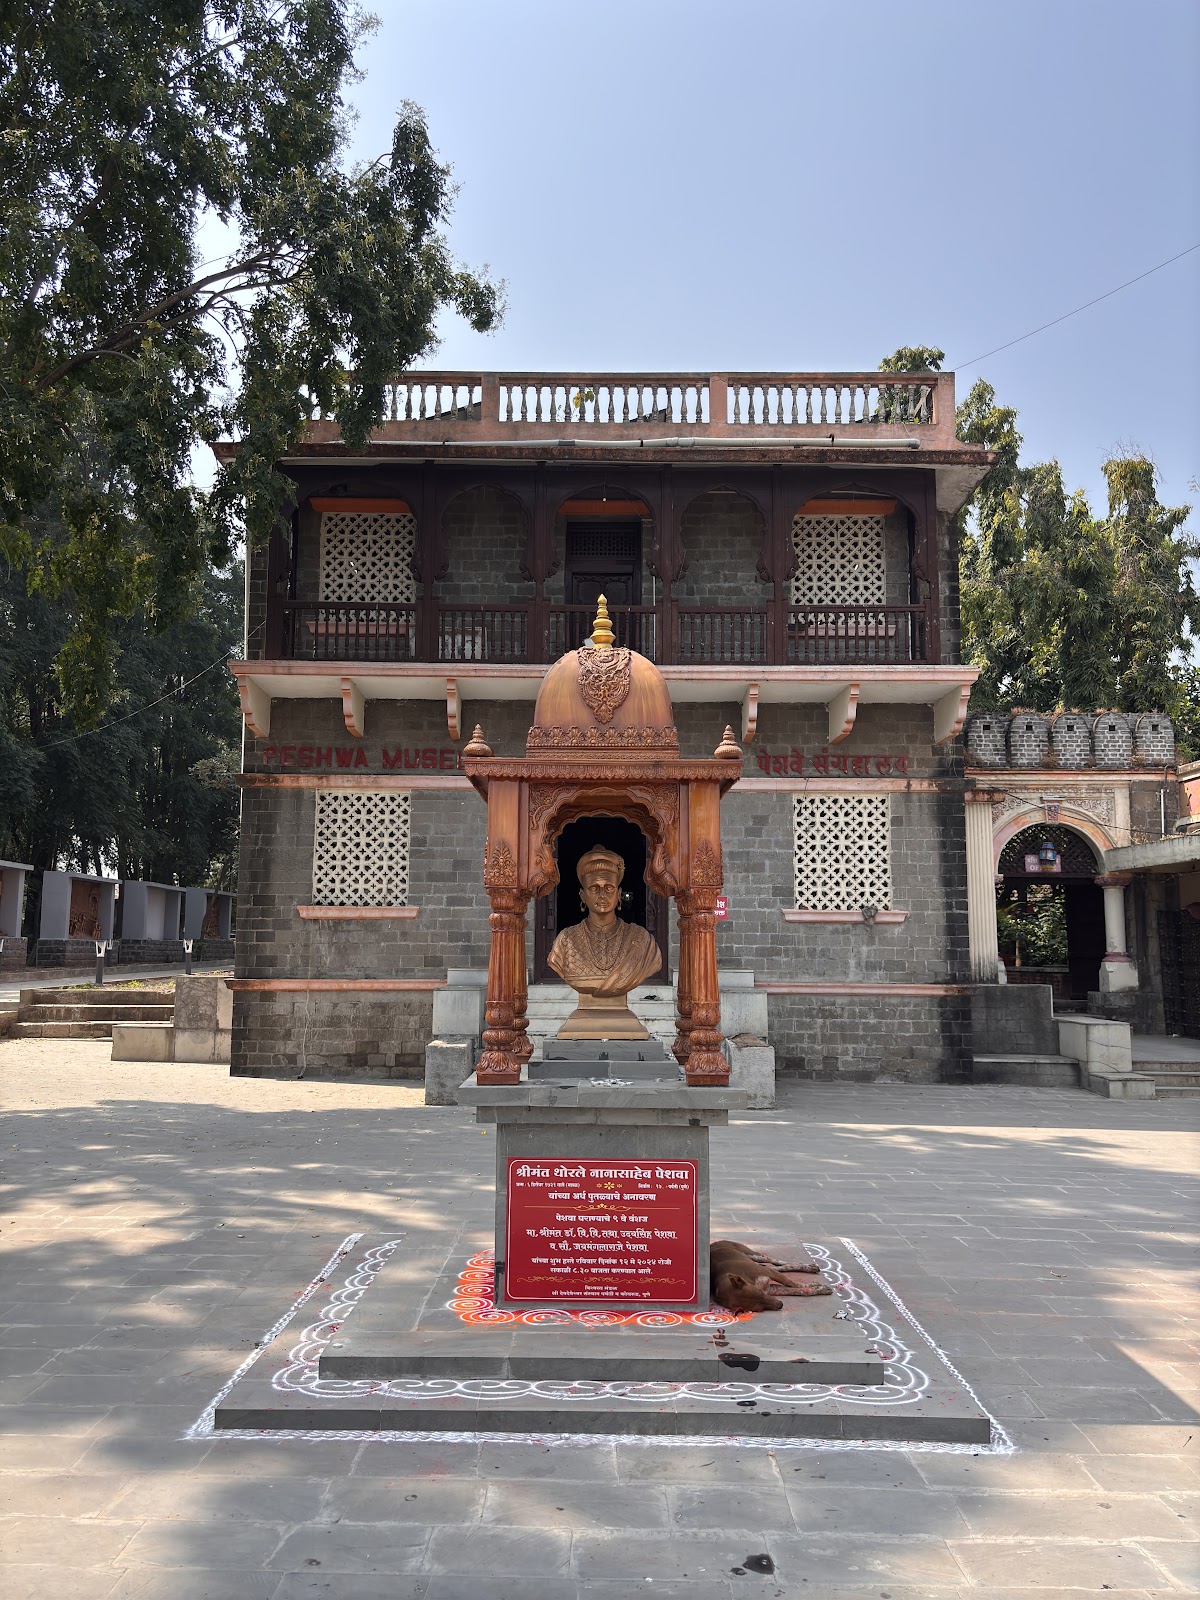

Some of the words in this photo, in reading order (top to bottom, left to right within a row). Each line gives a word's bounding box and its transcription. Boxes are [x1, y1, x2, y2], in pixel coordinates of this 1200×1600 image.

[263, 746, 368, 768] PESHWA
[756, 748, 804, 775] पेशवे
[516, 1165, 550, 1177] श्रीमंत
[554, 1165, 586, 1177] थोरले
[590, 1166, 652, 1179] नानासाहेब
[655, 1167, 689, 1179] पेशवा
[548, 1191, 570, 1199] यांच्या
[573, 1191, 586, 1199] अर्ध
[588, 1191, 620, 1203] पुतळ्याचे
[556, 1213, 576, 1221] पेशवा
[629, 1214, 648, 1222] वंशज
[539, 1227, 563, 1237] श्रीमंत
[620, 1228, 652, 1239] उदयसिंह
[654, 1228, 677, 1239] पेशवा
[626, 1241, 649, 1252] पेशवा
